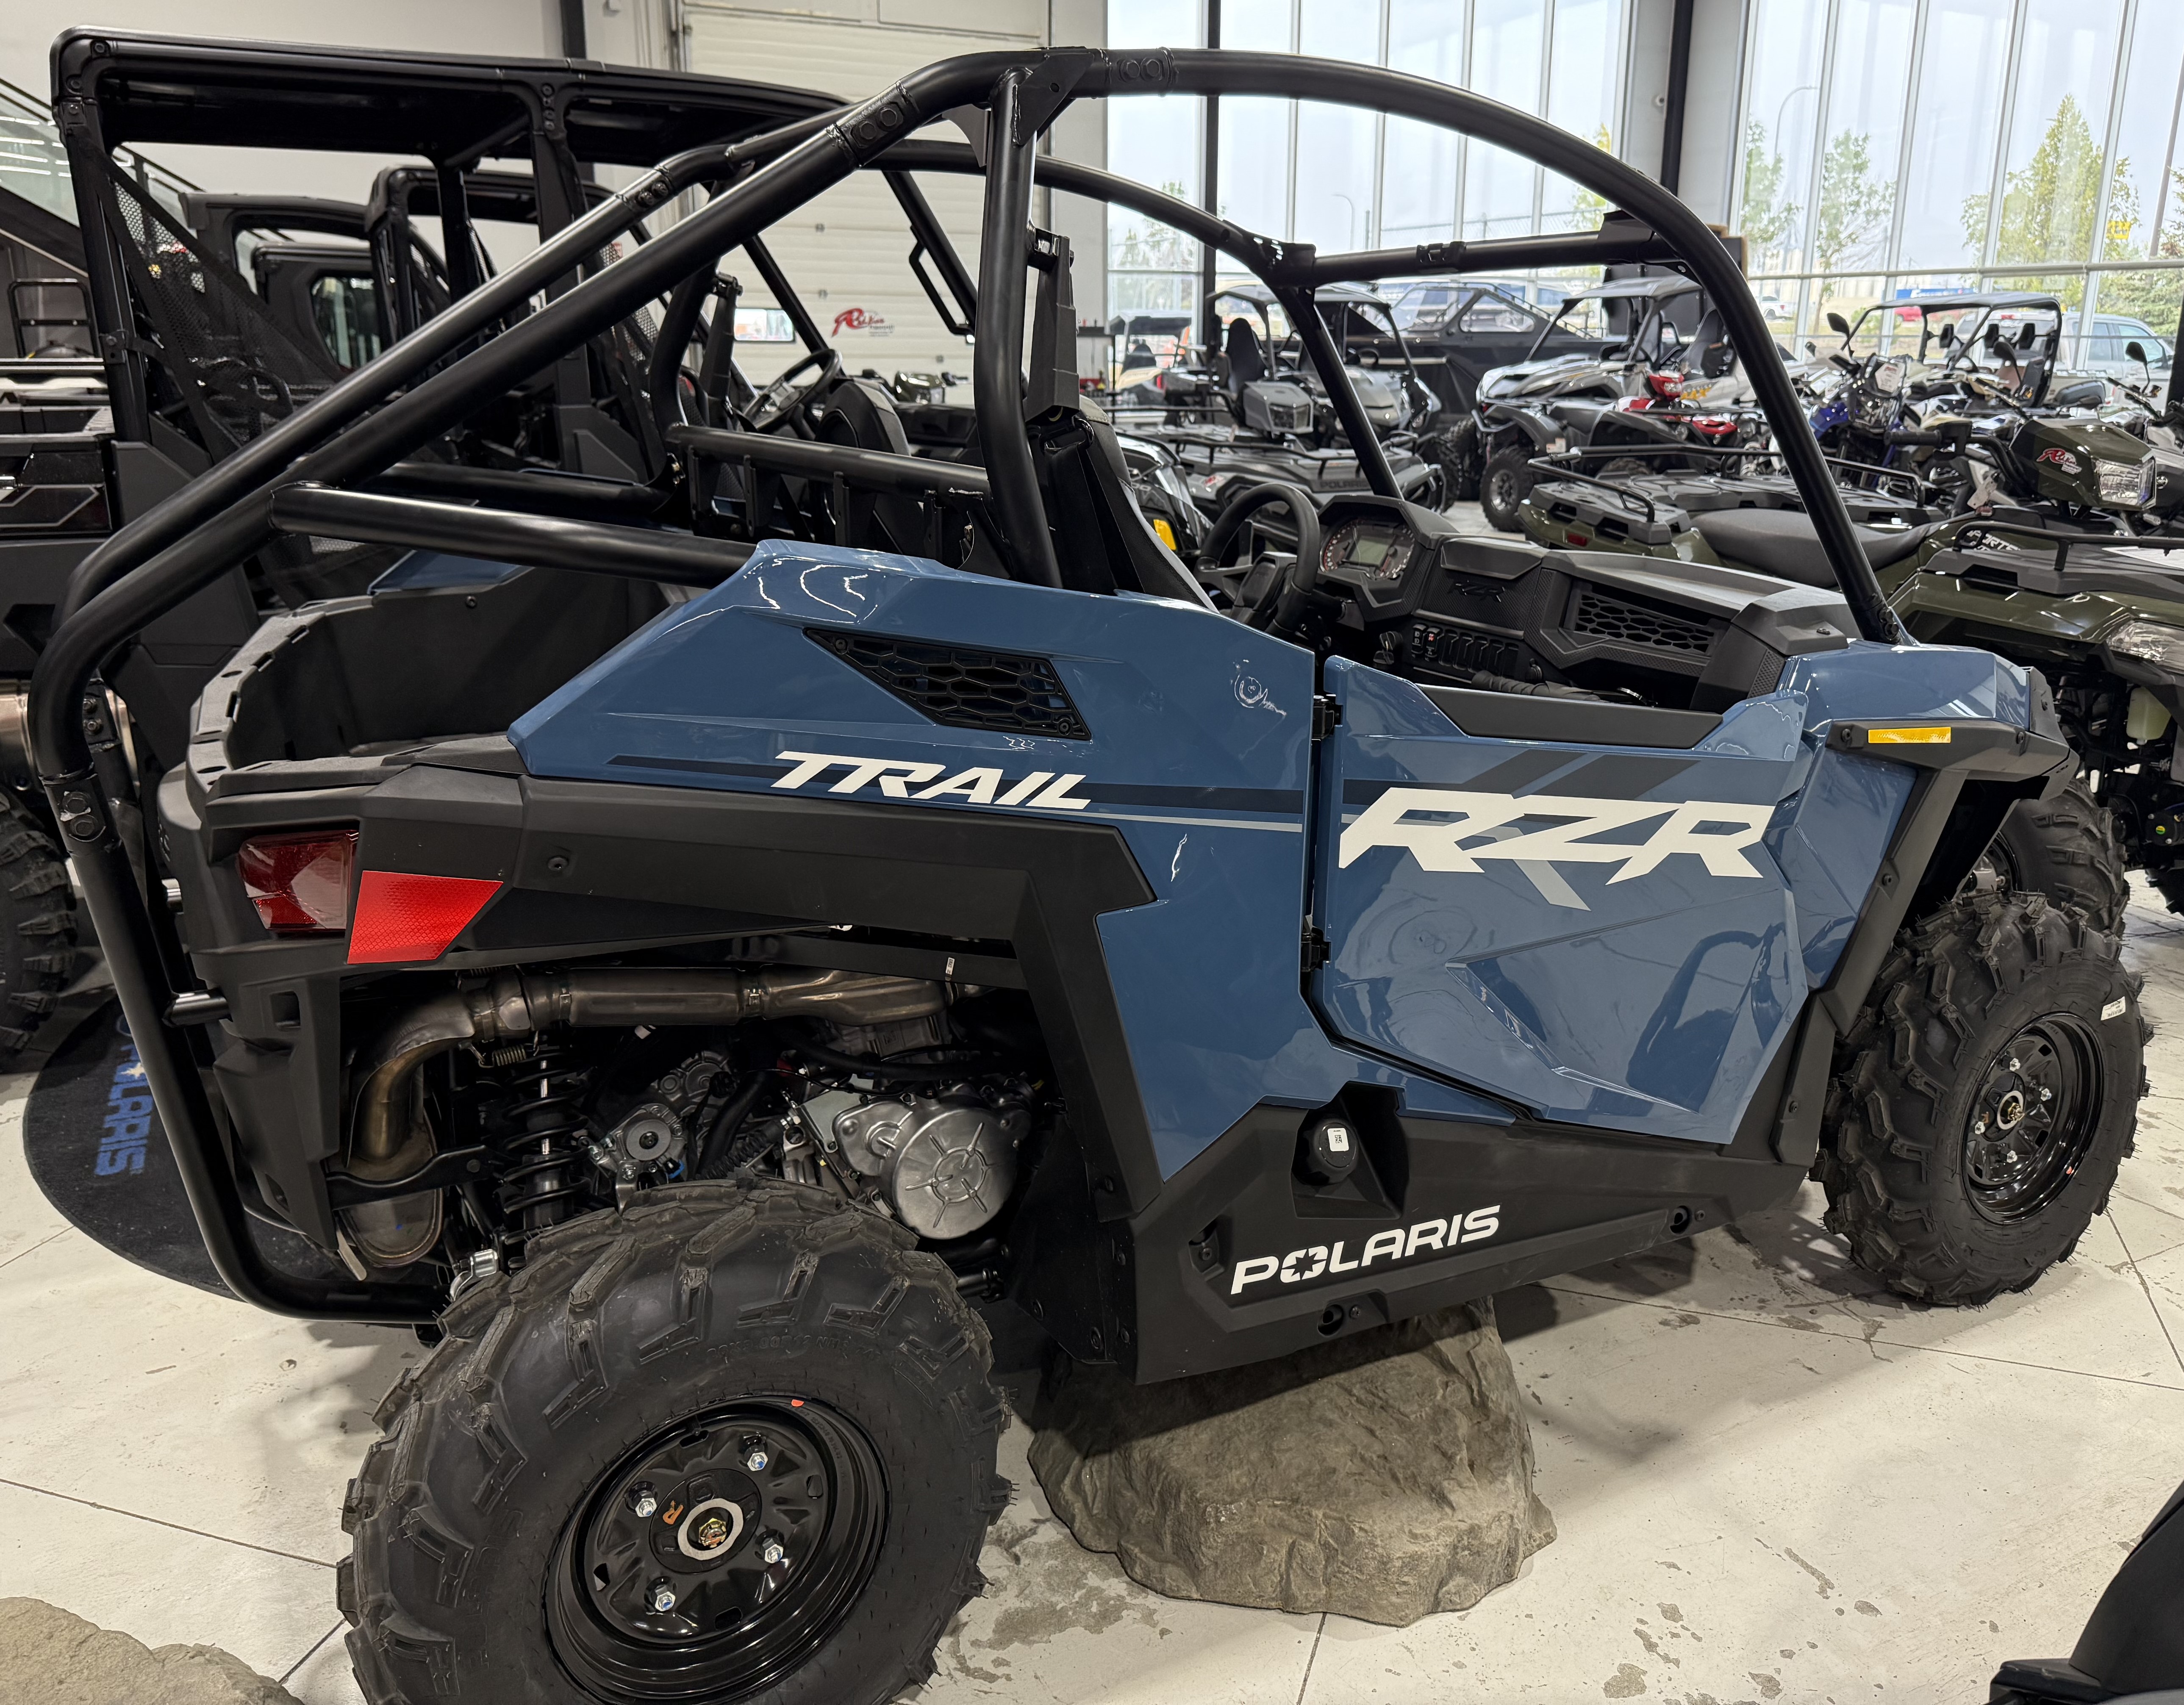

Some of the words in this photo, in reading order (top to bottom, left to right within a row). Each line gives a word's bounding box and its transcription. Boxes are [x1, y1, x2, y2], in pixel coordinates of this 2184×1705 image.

[770, 750, 1091, 810] TRAIL
[1338, 787, 1776, 885] RZR
[1230, 1204, 1501, 1295] POLARIS
